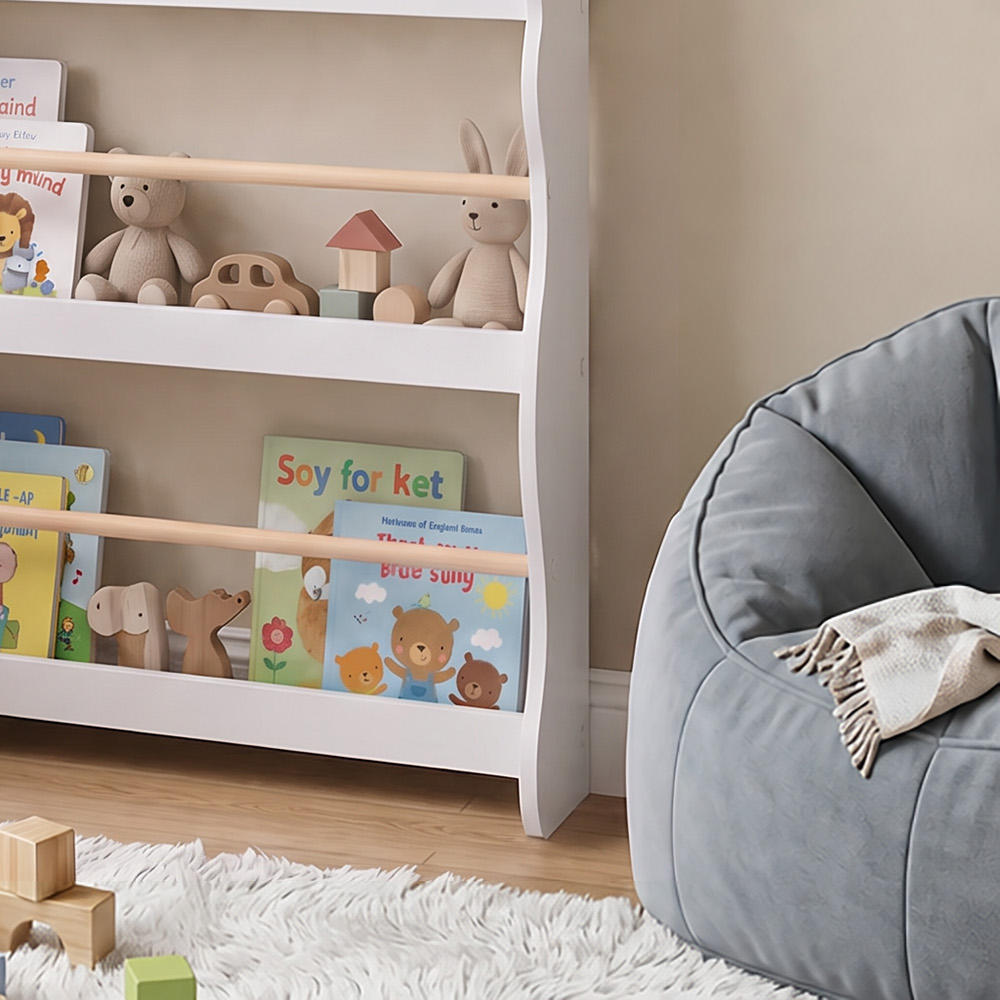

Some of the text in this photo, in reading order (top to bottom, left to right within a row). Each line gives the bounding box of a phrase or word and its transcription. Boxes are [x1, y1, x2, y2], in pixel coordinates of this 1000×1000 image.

[276, 453, 444, 500] Soy for ket
[418, 519, 428, 529] of
